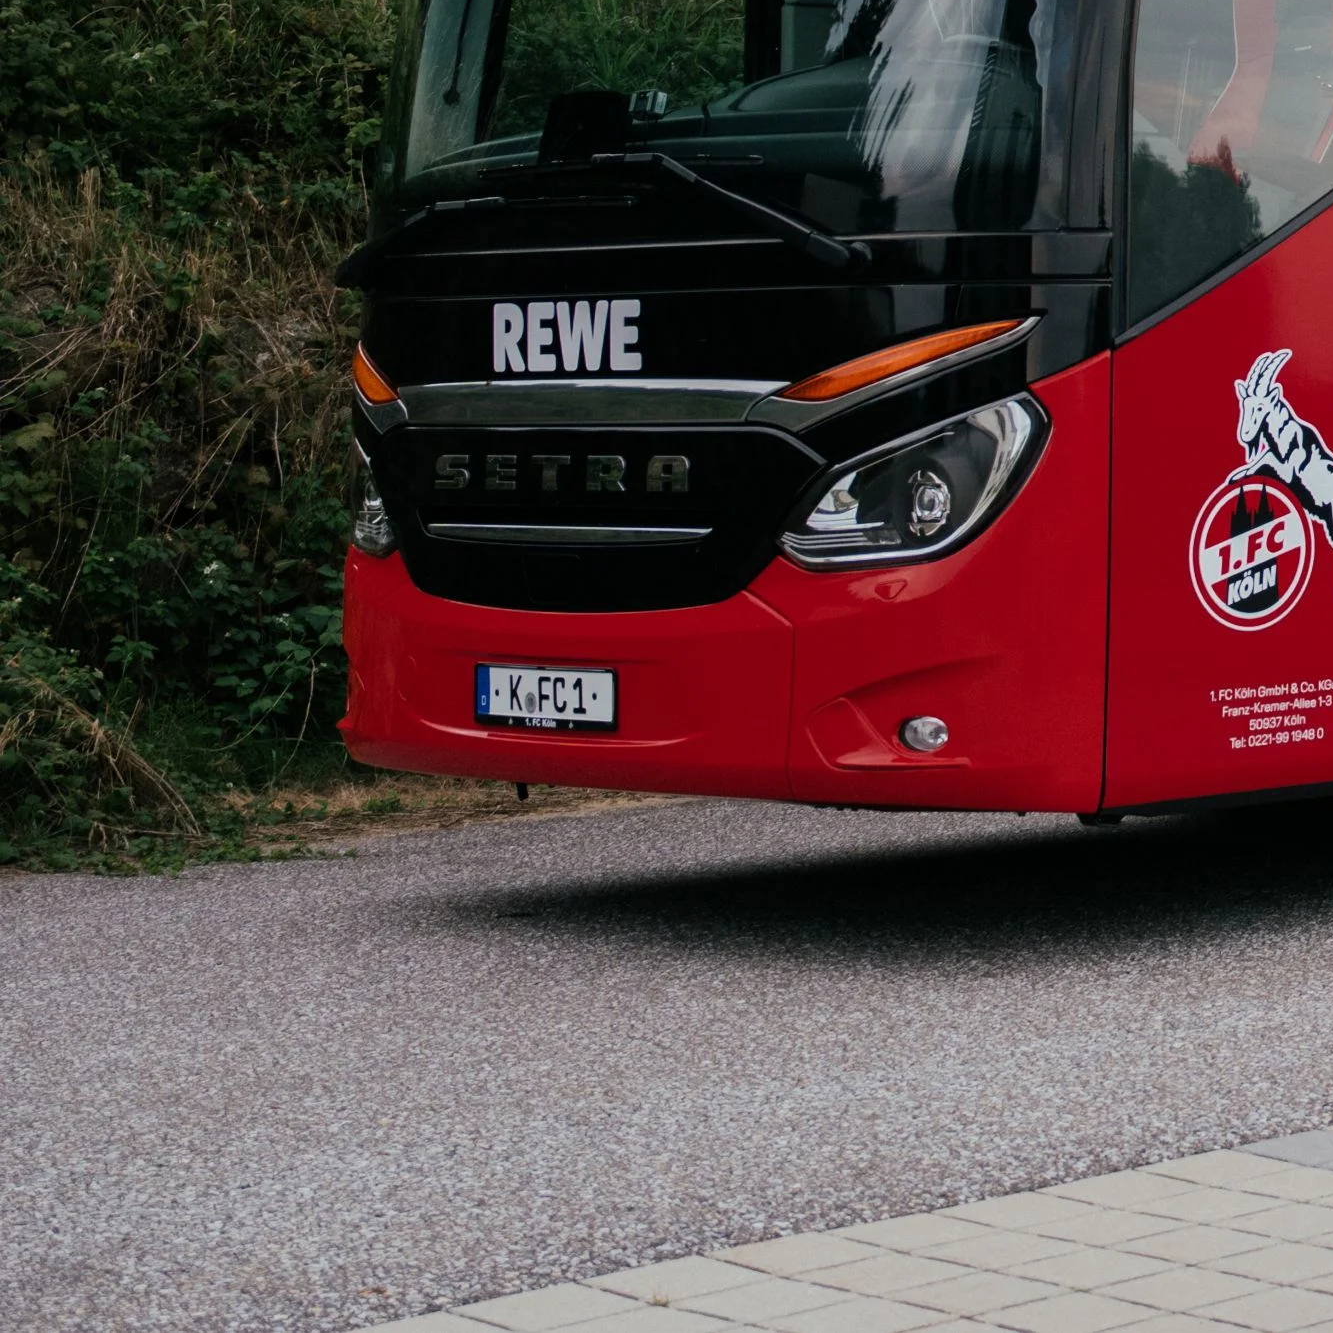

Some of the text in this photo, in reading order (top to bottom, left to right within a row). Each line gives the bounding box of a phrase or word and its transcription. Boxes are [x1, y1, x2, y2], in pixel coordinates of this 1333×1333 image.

[493, 299, 642, 372] REWE
[434, 454, 690, 492] SETRA
[1227, 564, 1277, 606] KÖLN
[509, 674, 523, 711] K
[1210, 690, 1217, 702] 1.
[1218, 689, 1233, 701] FC
[1234, 687, 1256, 699] Köln
[1257, 683, 1289, 698] GmbH
[1290, 682, 1299, 694] &
[1300, 681, 1317, 693] Co.
[1222, 695, 1333, 718] Franz-Kremer-Allee 1-3
[532, 718, 541, 727] FC
[542, 718, 557, 728] Köln
[1249, 714, 1306, 731] 50937 Köln
[1248, 732, 1290, 747] 0221-99
[1291, 729, 1315, 743] 1948
[1317, 727, 1325, 739] 0
